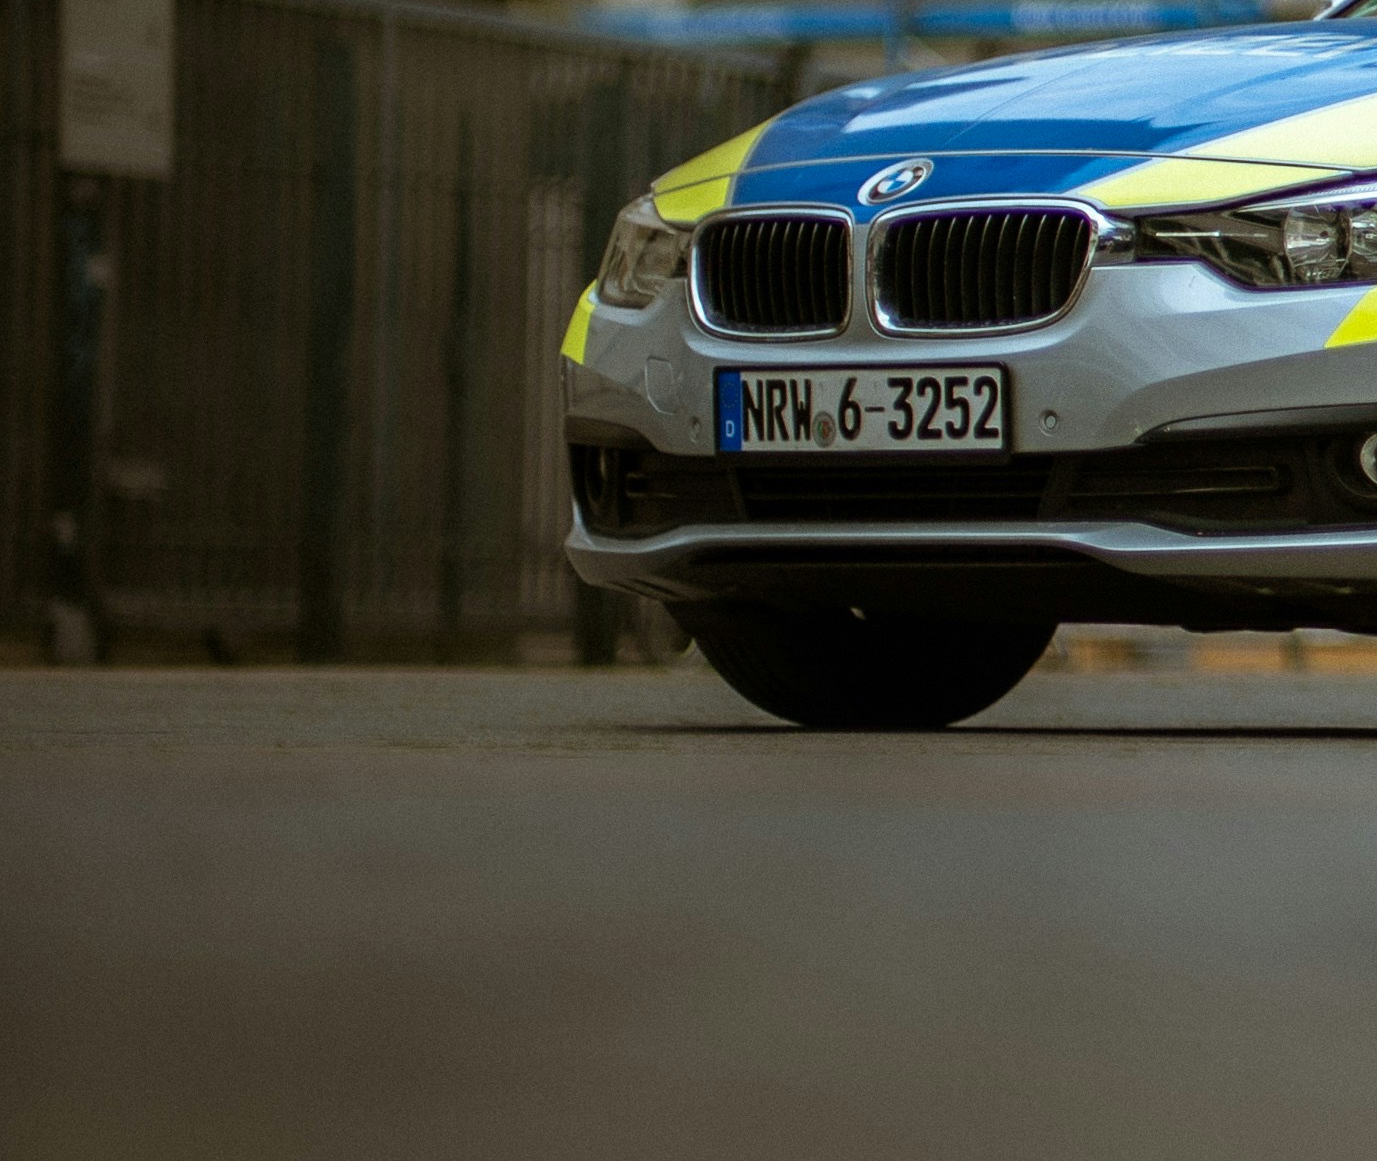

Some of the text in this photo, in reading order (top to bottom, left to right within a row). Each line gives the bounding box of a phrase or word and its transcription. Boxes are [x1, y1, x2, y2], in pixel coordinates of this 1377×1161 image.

[724, 419, 736, 438] D
[741, 374, 1001, 442] NRW 6-3252
